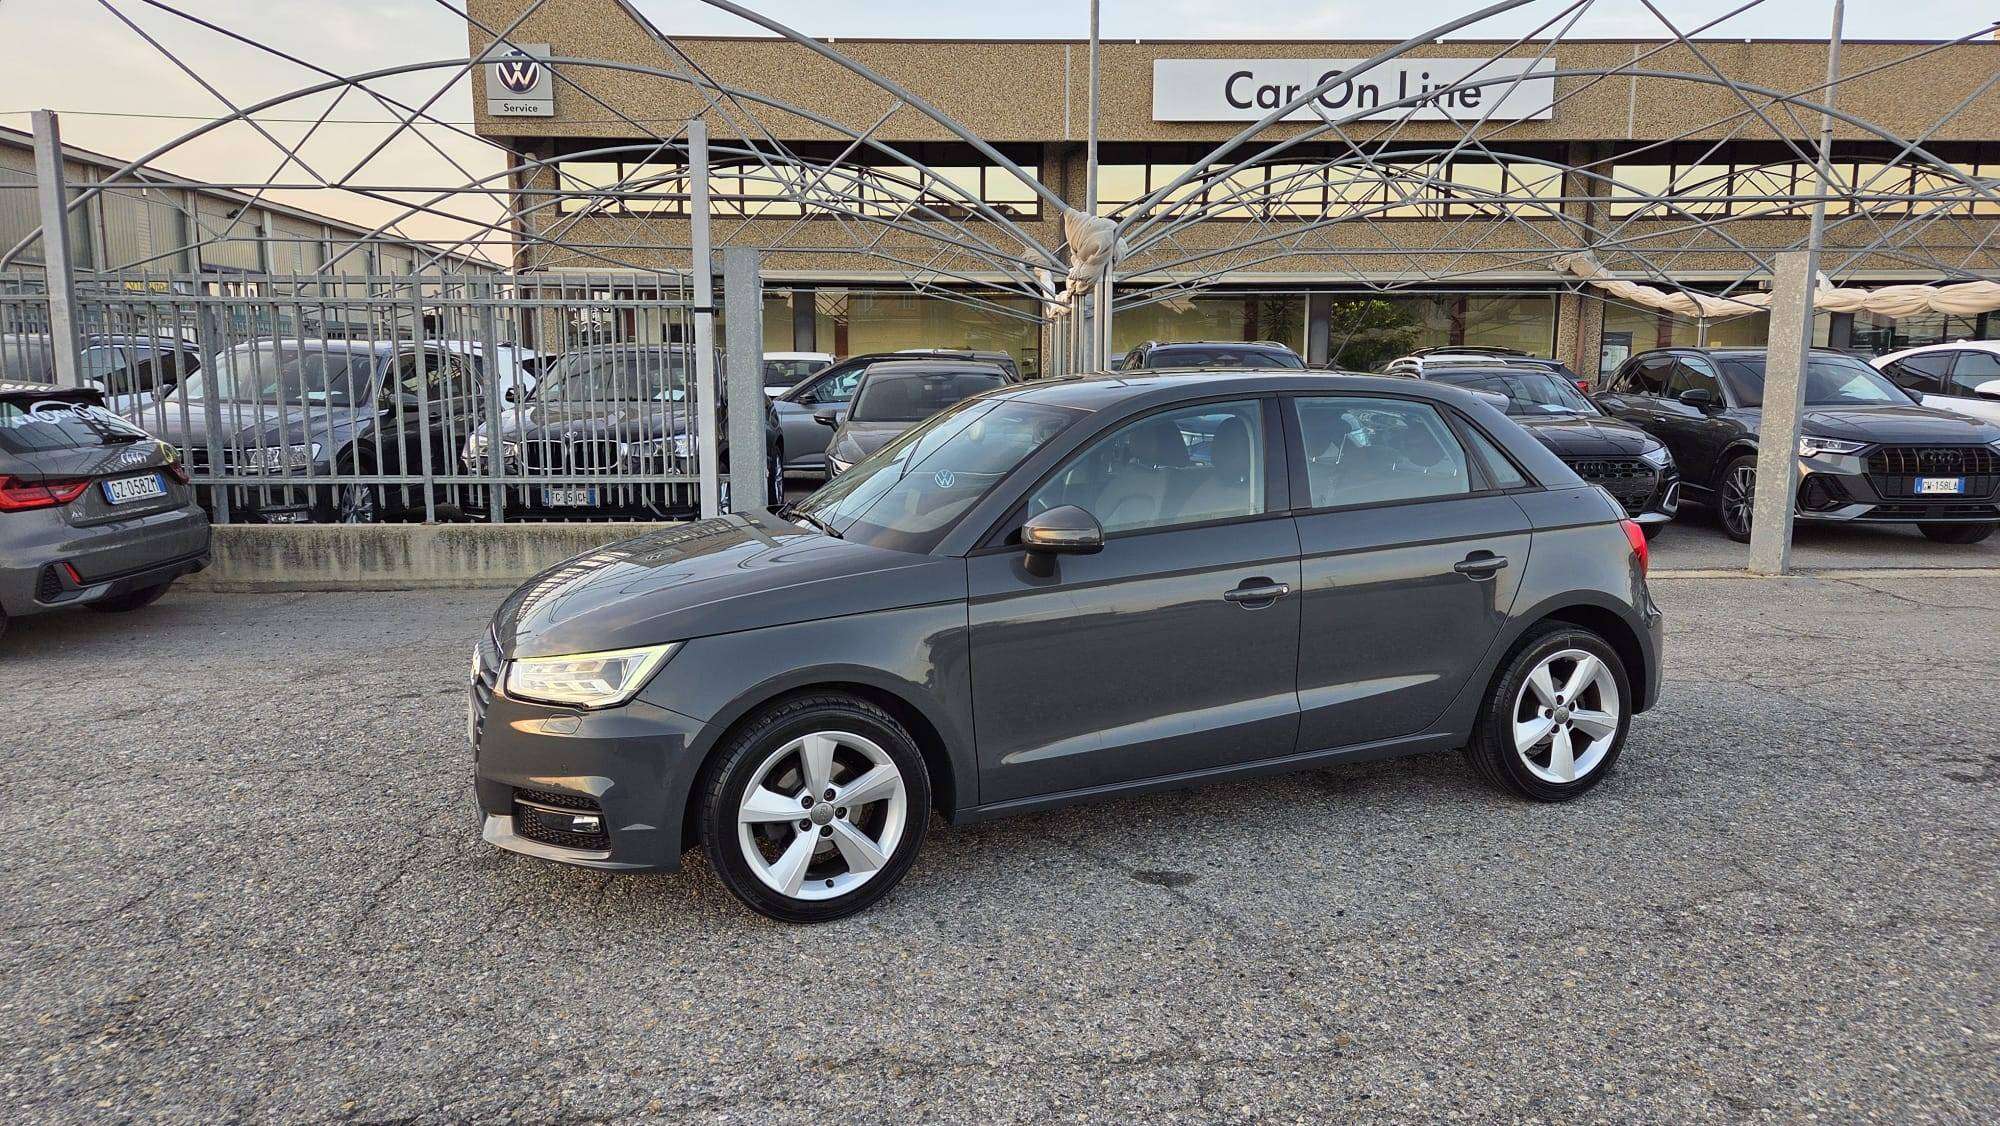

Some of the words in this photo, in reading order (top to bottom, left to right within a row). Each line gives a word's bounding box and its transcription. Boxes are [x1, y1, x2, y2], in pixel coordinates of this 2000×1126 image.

[1225, 70, 1301, 109] Car
[1316, 70, 1379, 109] On
[1399, 70, 1481, 108] Line
[503, 103, 538, 113] Service
